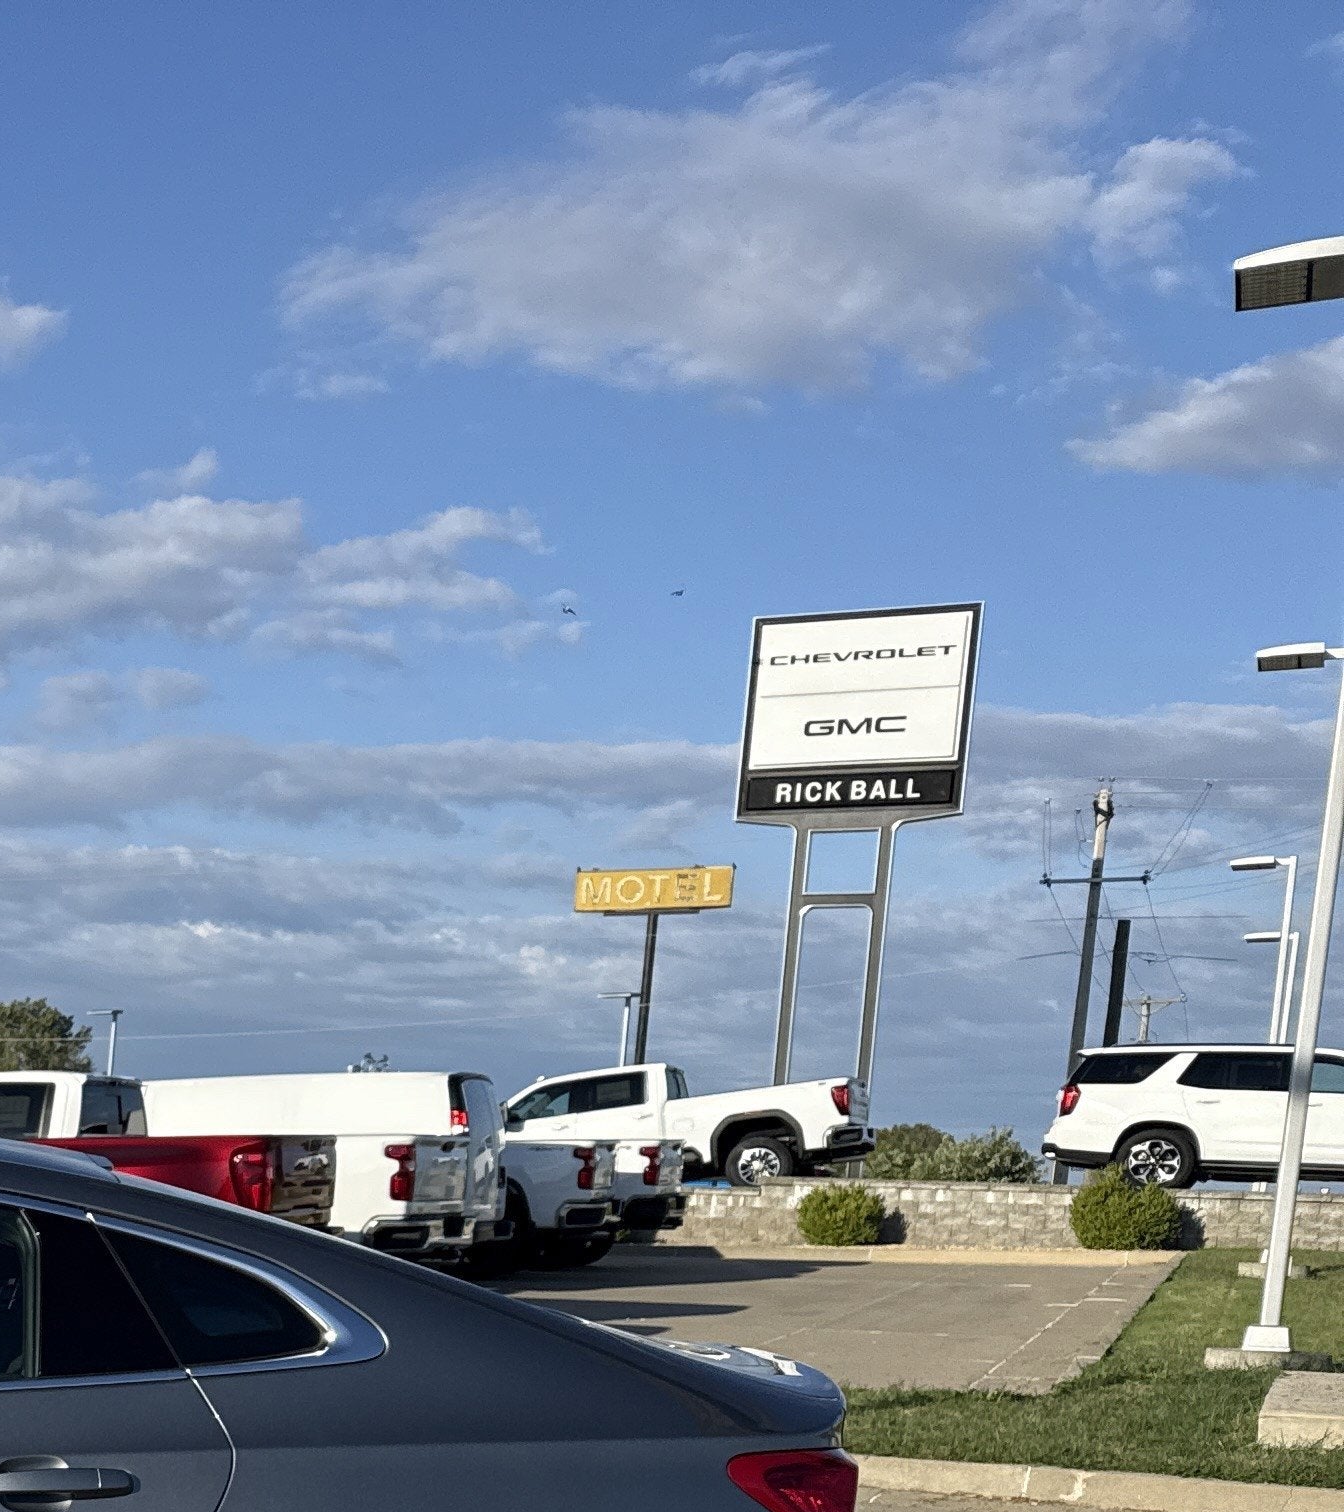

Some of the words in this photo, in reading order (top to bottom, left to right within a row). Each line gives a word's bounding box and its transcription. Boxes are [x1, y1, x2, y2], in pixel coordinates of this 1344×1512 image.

[769, 644, 957, 667] CHEVROLET
[804, 715, 908, 738] GMC
[775, 780, 843, 804] RICK
[850, 777, 922, 801] BALL
[580, 871, 723, 905] MOTEL
